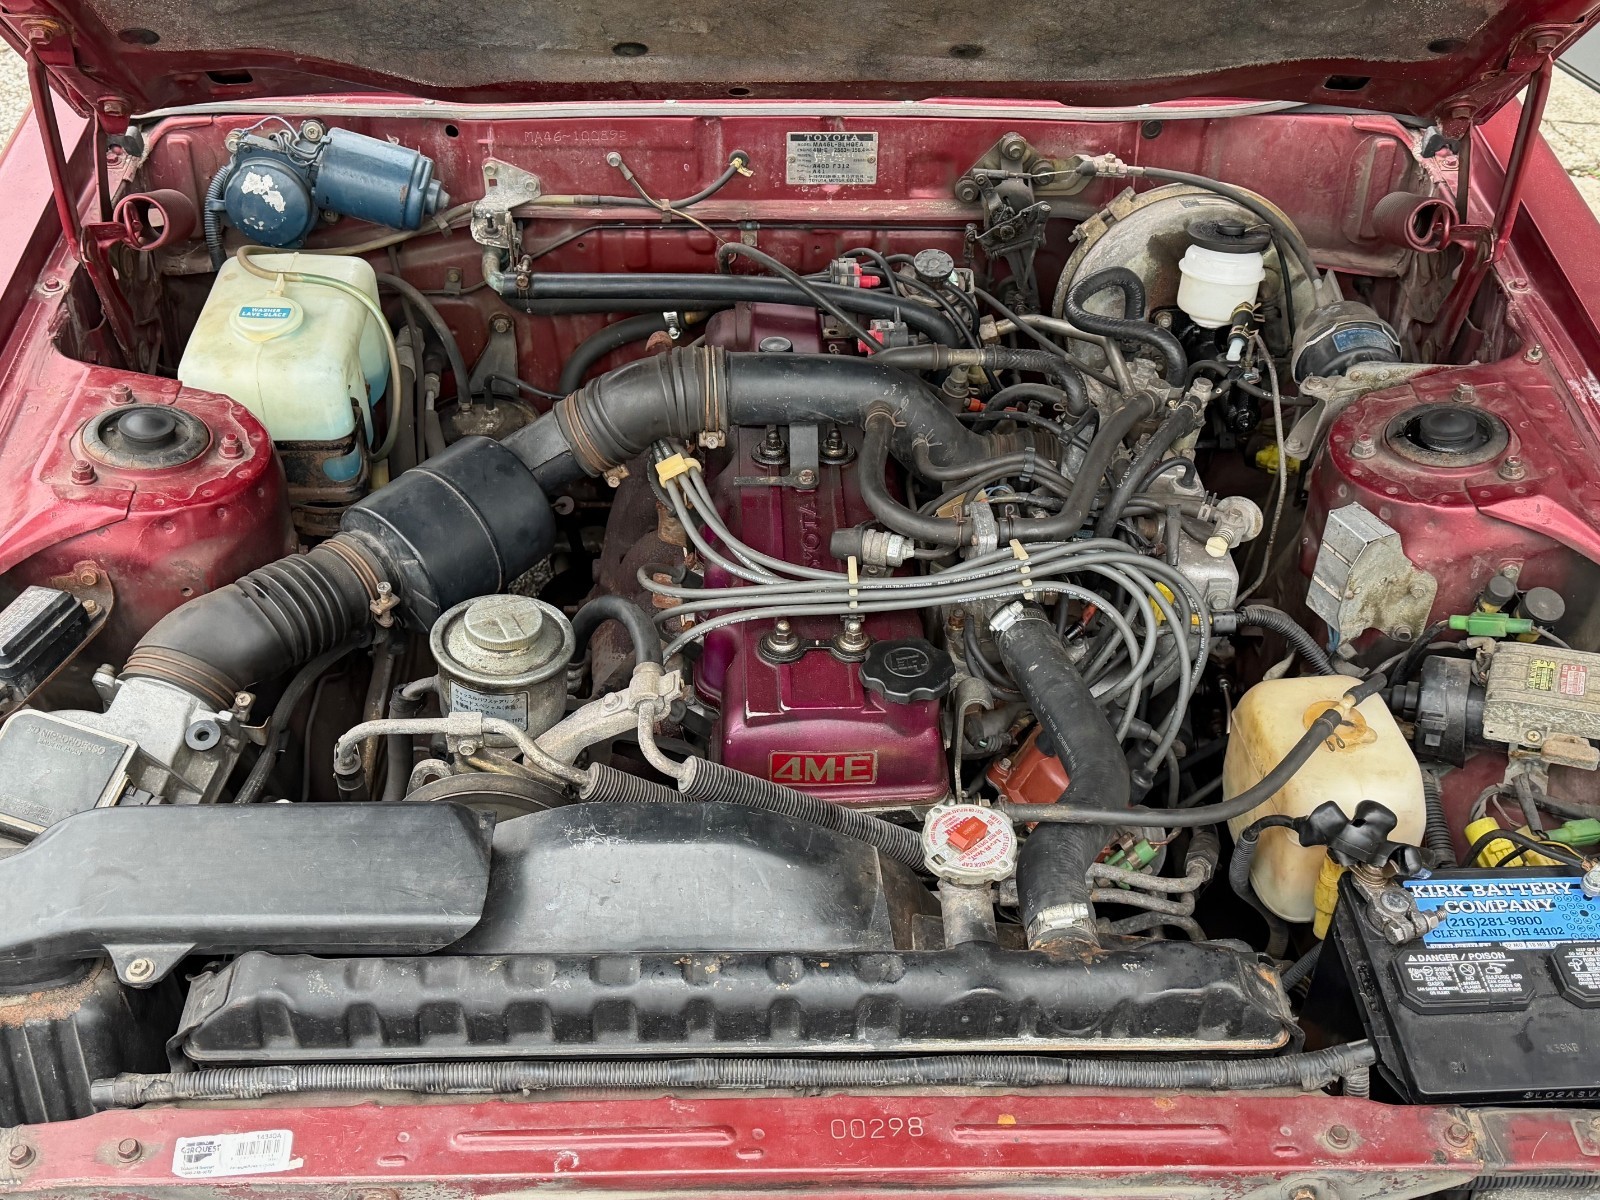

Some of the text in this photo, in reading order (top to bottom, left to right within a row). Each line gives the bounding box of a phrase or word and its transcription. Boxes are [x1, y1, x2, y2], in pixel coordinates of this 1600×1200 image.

[953, 573, 986, 583] OPTI-LAYER
[774, 755, 871, 782] 4M-E
[1409, 882, 1572, 899] KIRK BATTERY
[1444, 898, 1555, 914] COMPANY
[1445, 915, 1543, 930] (216)281-9800
[1432, 926, 1565, 939] CLEVELAND, OH 44102
[1417, 953, 1459, 962] DANGER
[1468, 951, 1506, 960] POISON
[830, 1116, 924, 1140] 00298
